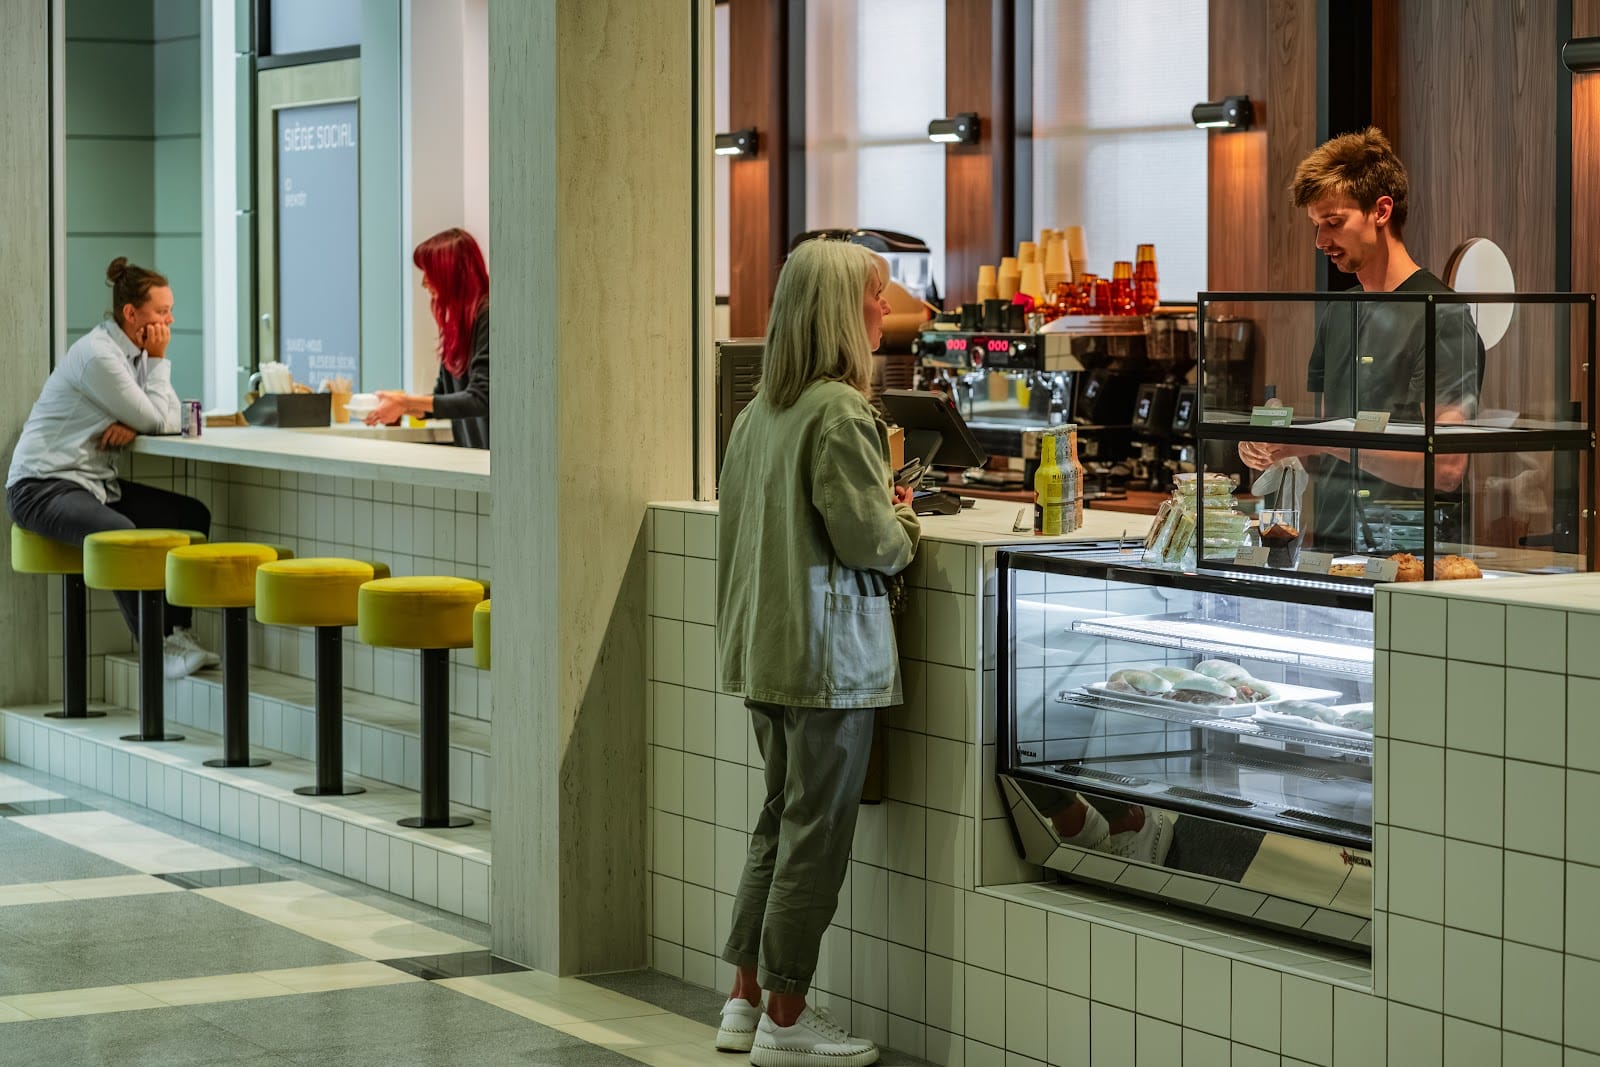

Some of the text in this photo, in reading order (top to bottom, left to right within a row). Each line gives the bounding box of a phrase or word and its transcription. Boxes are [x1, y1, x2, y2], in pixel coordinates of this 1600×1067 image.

[284, 122, 356, 152] SIÈGE SOCIAL
[988, 340, 1009, 352] 000
